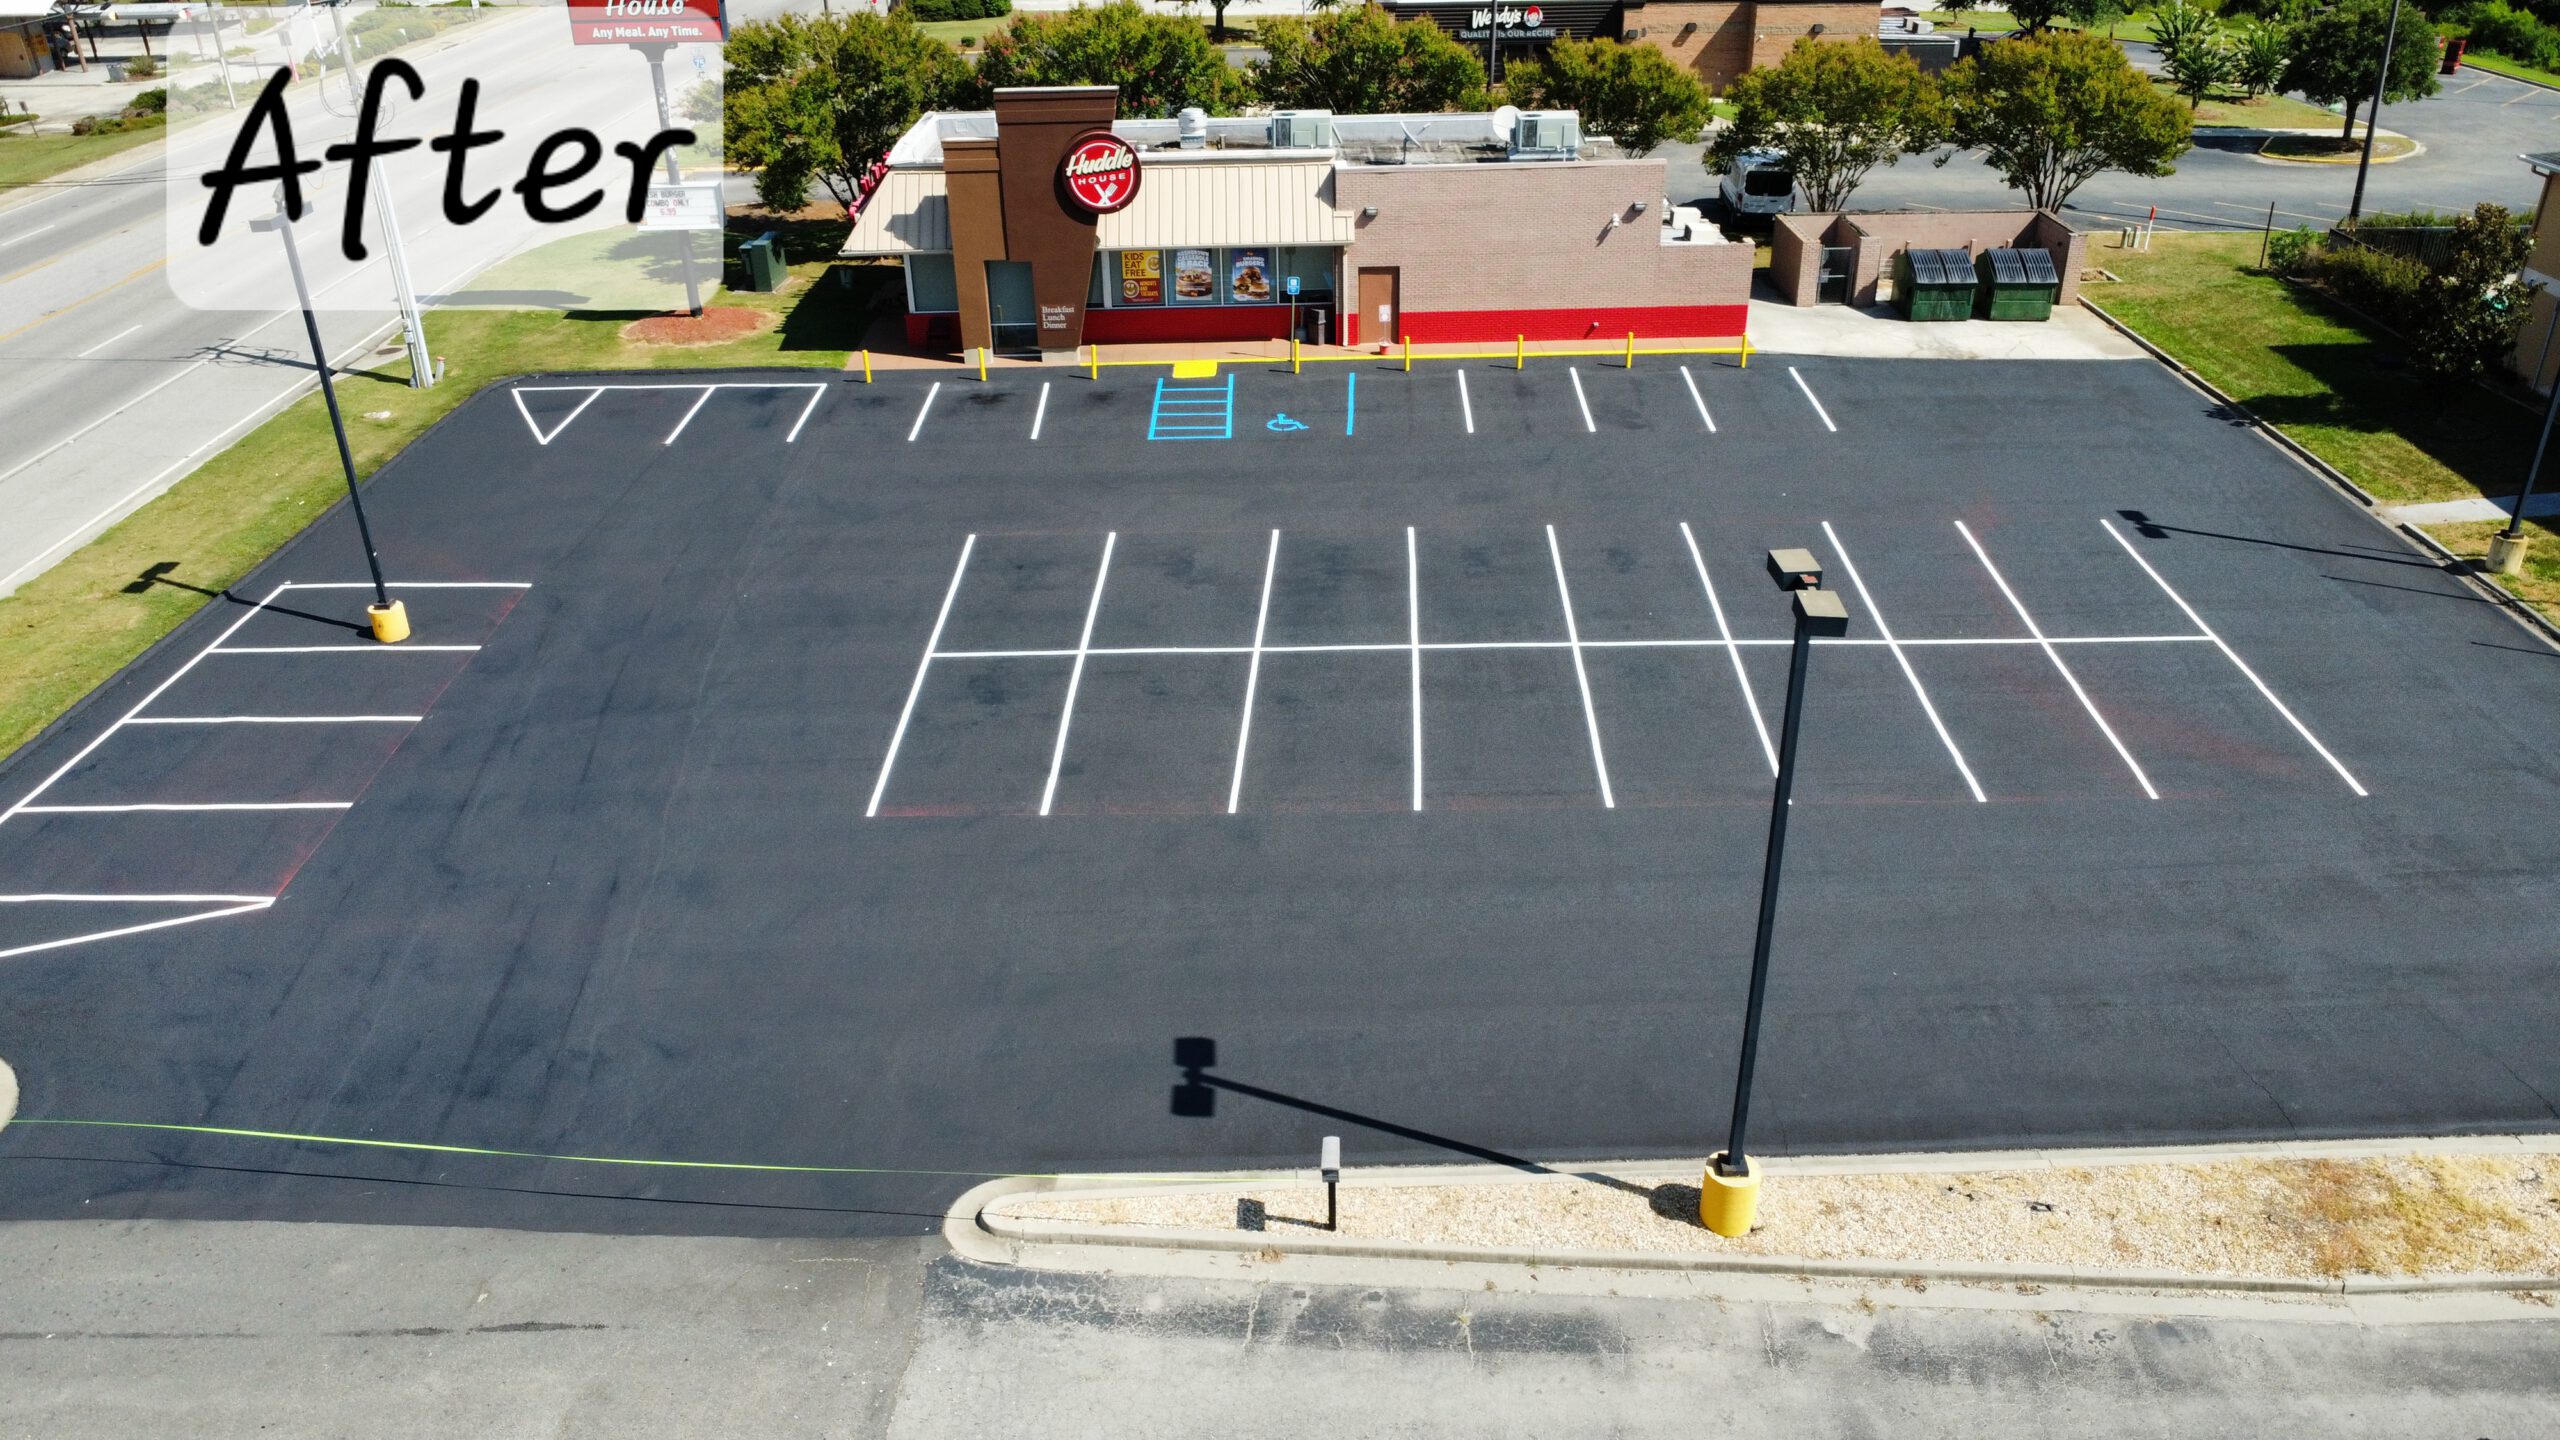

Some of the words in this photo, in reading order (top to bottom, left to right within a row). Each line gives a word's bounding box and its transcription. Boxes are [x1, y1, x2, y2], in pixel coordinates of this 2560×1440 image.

[605, 0, 685, 16] House
[592, 27, 613, 39] Any
[615, 26, 646, 37] Meal.
[648, 26, 669, 39] Any
[671, 26, 703, 36] Time.
[1460, 30, 1490, 39] QUALIT
[1498, 30, 1506, 38] IS
[1507, 29, 1525, 38] OUR
[1527, 29, 1557, 37] RECIPE
[1065, 146, 1133, 177] Huddle
[1078, 173, 1126, 185] HOUSE
[661, 190, 686, 199] BURGER
[673, 199, 689, 207] ONLY
[1124, 252, 1144, 261] KIDS
[1124, 261, 1141, 269] EAT
[1125, 269, 1146, 277] FREE
[1042, 305, 1075, 313] Breakfast
[1042, 313, 1066, 321] Lunch
[1043, 321, 1067, 329] Dinner
